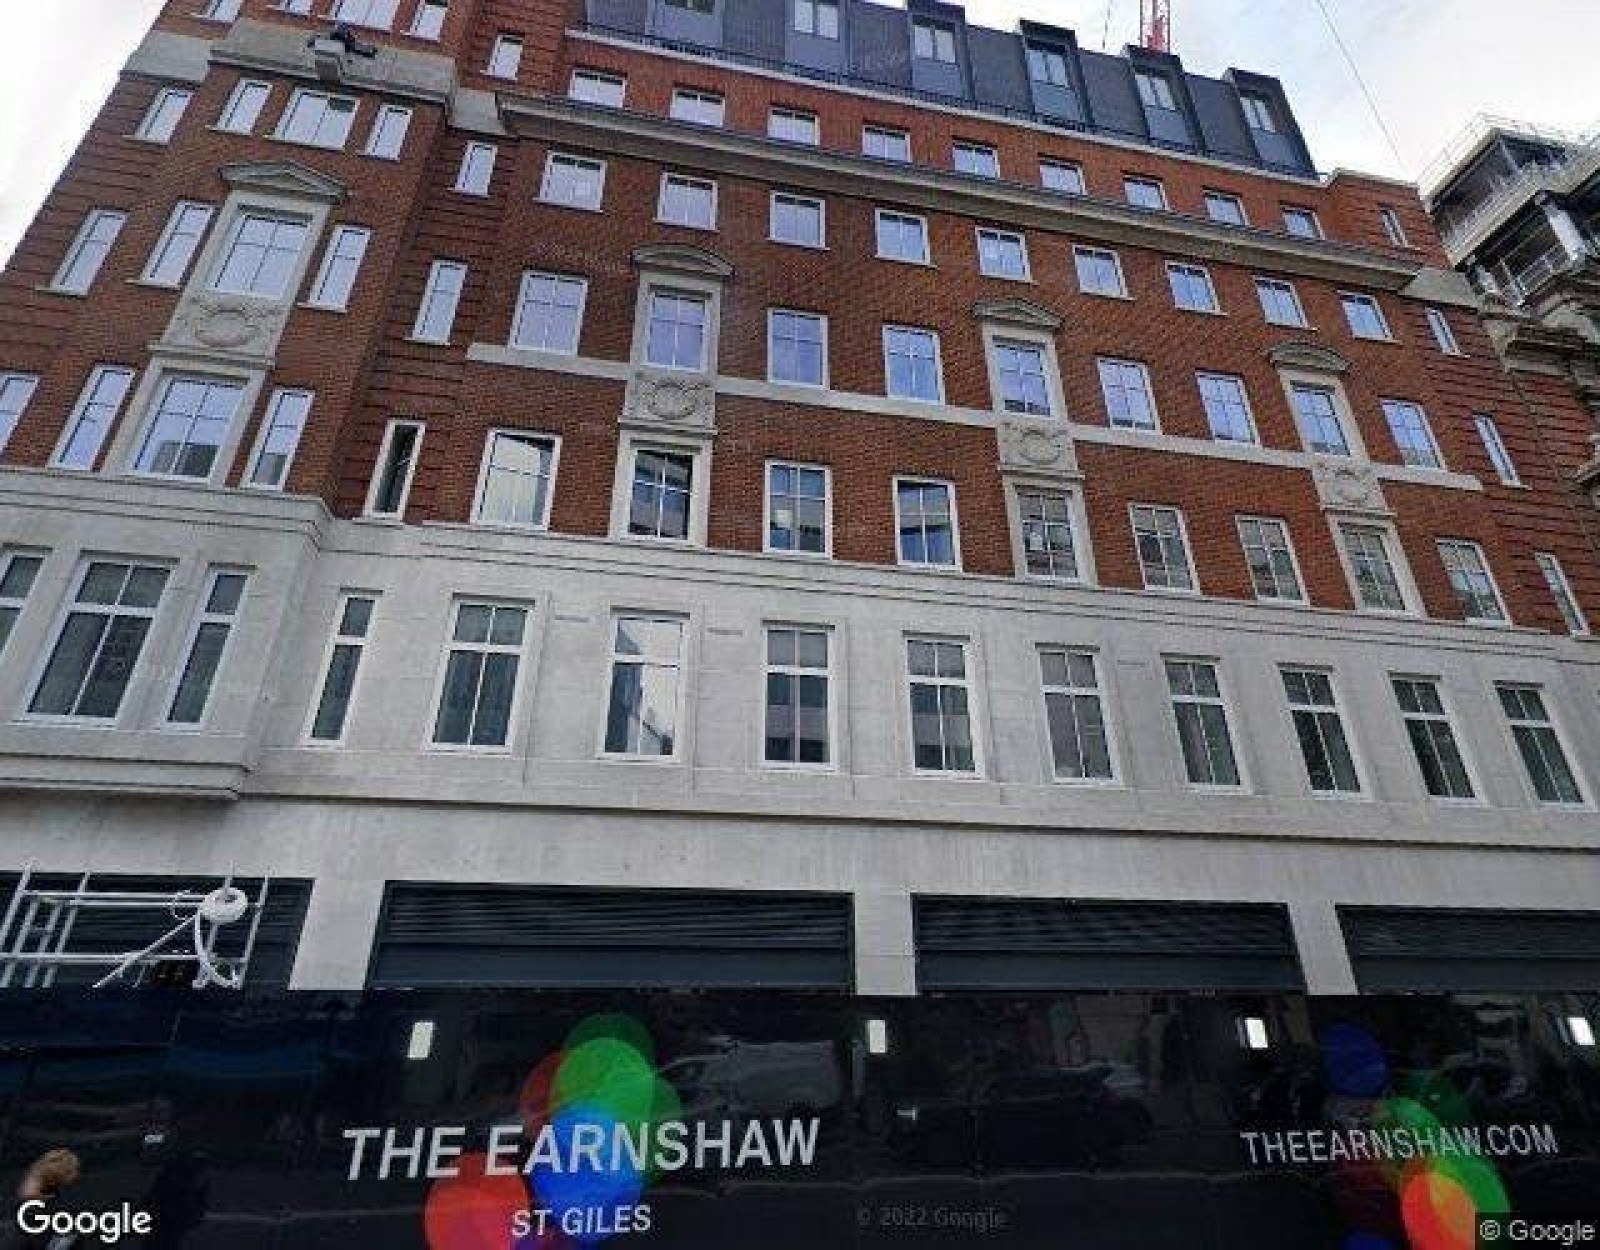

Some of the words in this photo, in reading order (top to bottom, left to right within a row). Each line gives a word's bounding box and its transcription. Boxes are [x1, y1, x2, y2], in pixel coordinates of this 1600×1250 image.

[343, 1126, 466, 1180] THE
[484, 1118, 820, 1176] EARNSHAW
[1240, 1124, 1559, 1163] THEEARNSHAW.COM
[511, 1209, 553, 1237] ST
[561, 1204, 651, 1236] GILES
